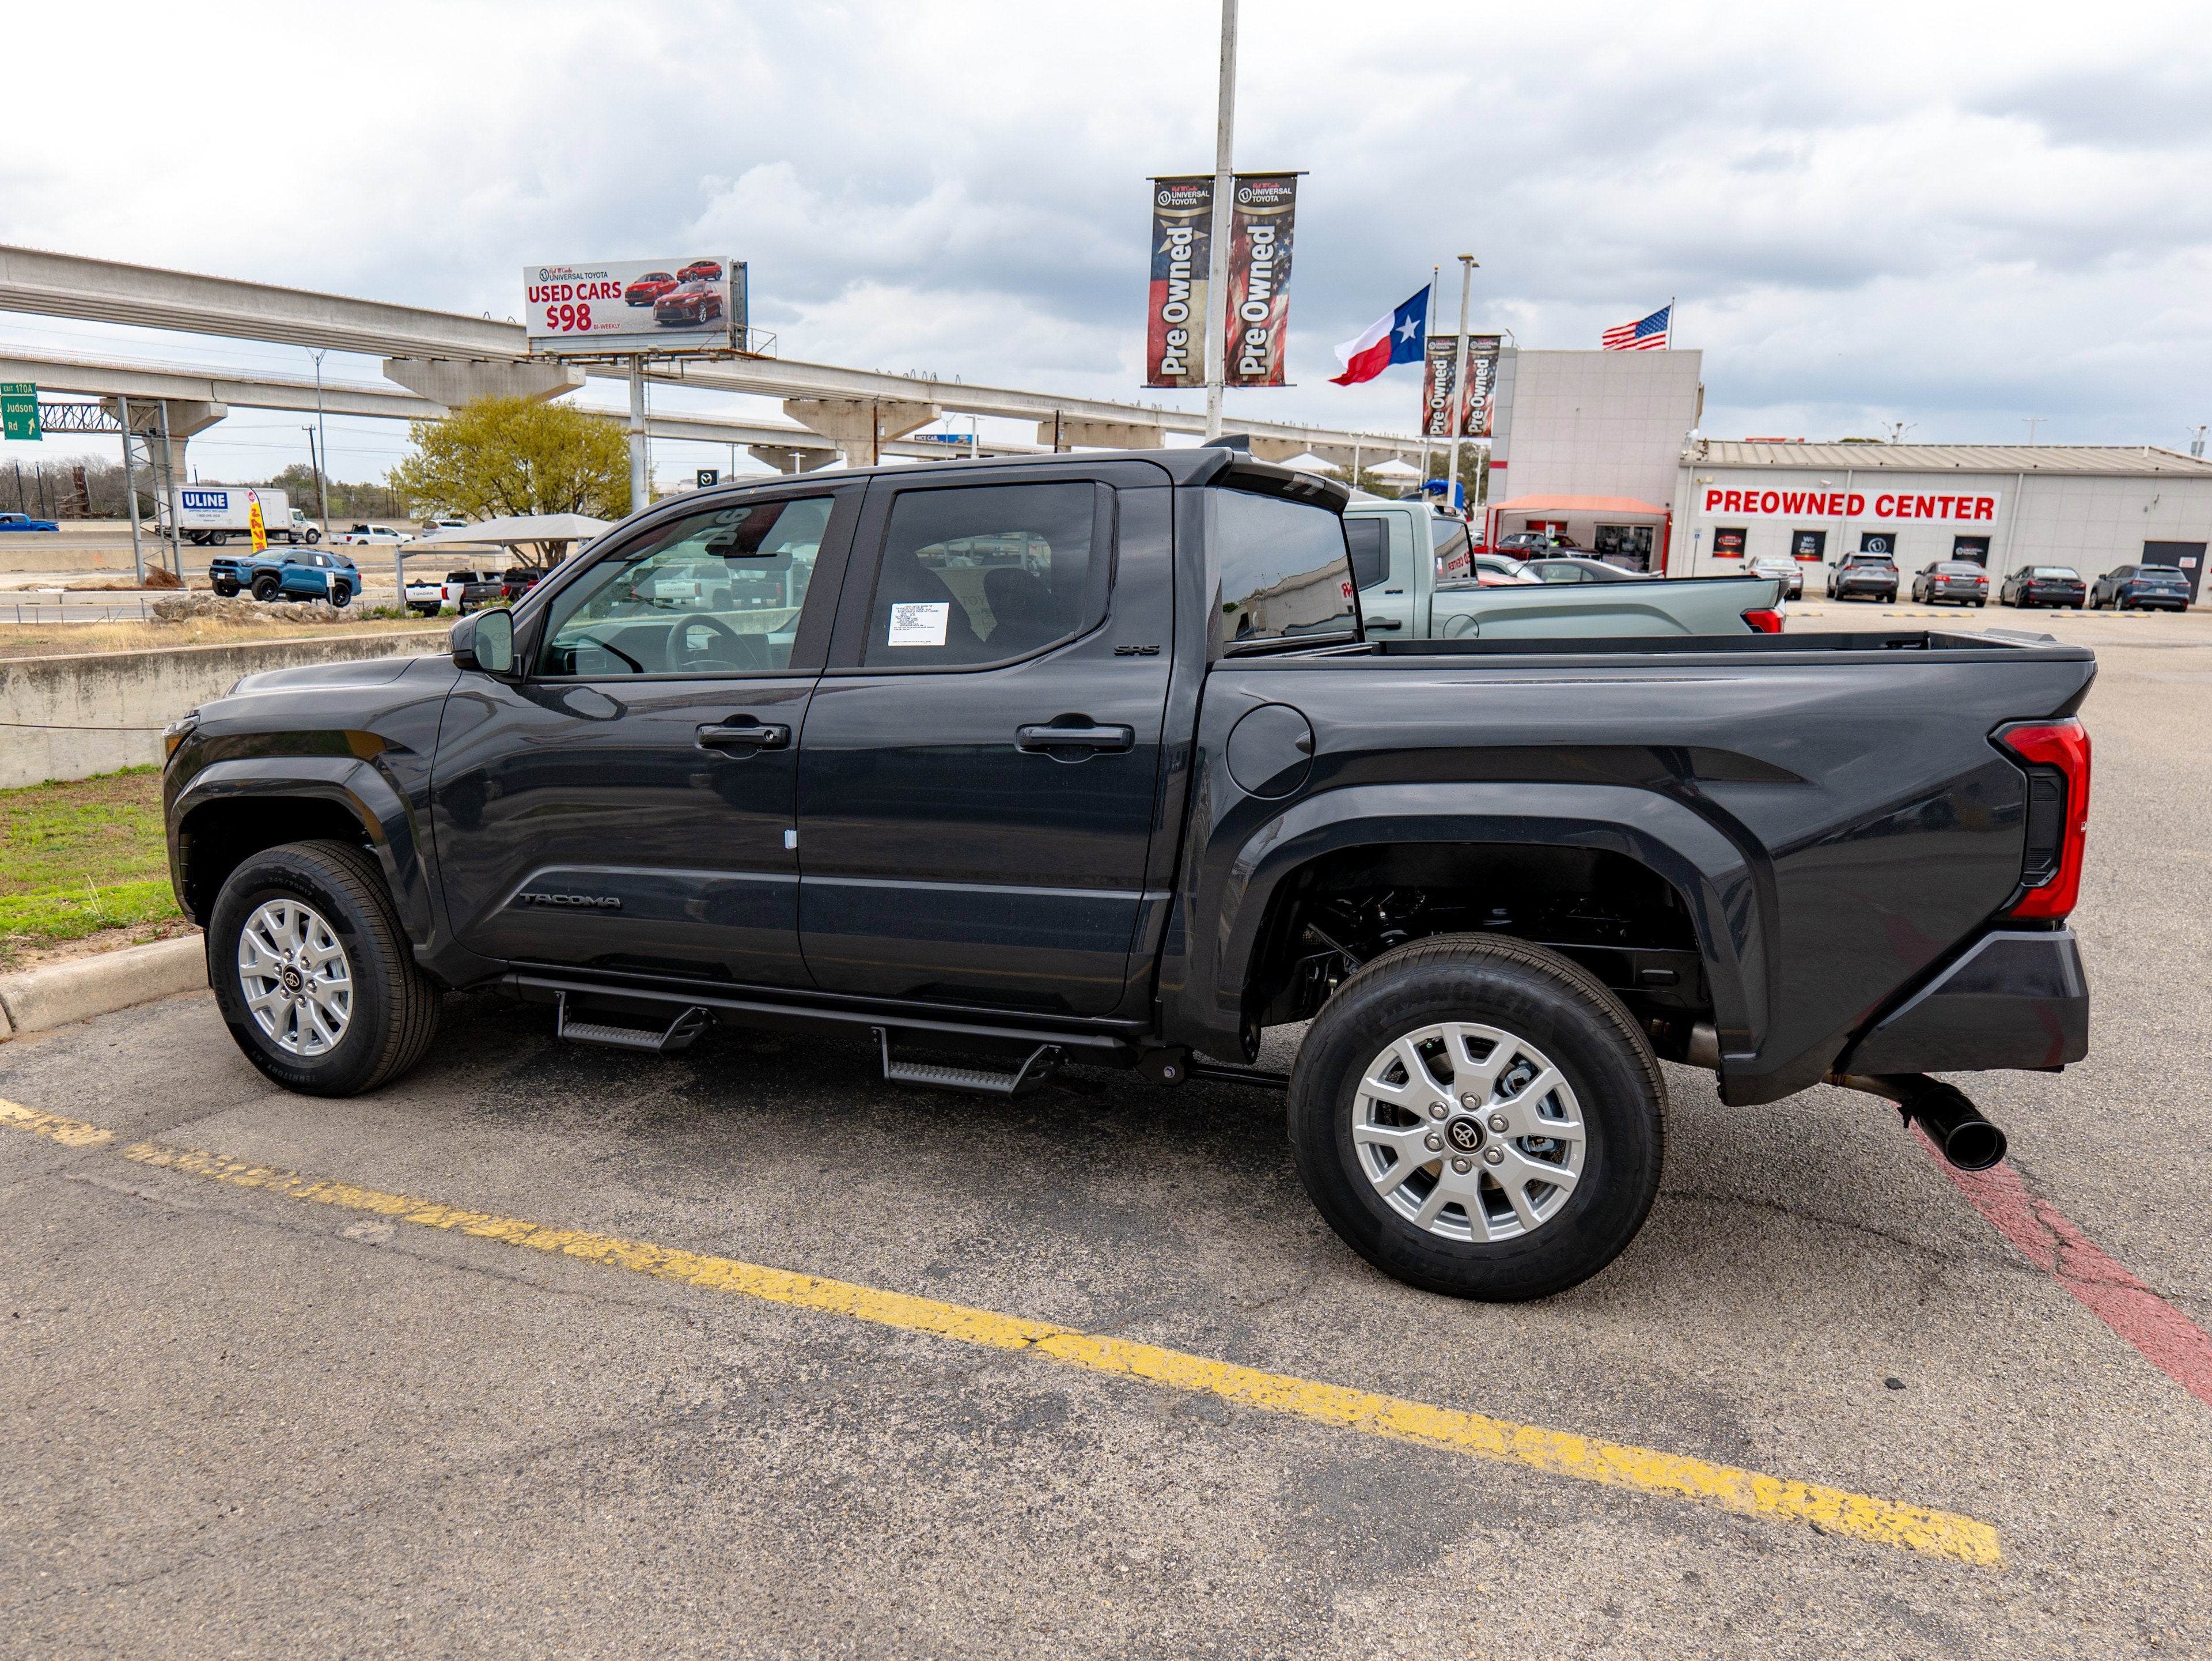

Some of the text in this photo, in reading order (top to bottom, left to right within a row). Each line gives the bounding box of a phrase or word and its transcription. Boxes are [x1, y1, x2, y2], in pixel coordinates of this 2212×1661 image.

[1171, 190, 1210, 199] UNIVERSAL
[1252, 187, 1292, 196] UNIVERSAL
[1171, 198, 1196, 206] TOYOTA
[1252, 195, 1279, 203] TOYOTA
[550, 271, 608, 281] UNIVERSAL TOYOTA
[528, 281, 622, 303] USED CARS
[1160, 226, 1193, 375] Pre Owned
[1239, 225, 1275, 375] Pre Owned
[547, 303, 592, 332] $98
[16, 384, 33, 393] 170A
[1430, 360, 1448, 409] Owned
[1470, 359, 1490, 408] Owned
[6, 403, 34, 413] Judson
[8, 421, 18, 431] Rd
[1429, 411, 1445, 435] Pre
[1468, 410, 1484, 433] Pre
[185, 494, 226, 506] ULINE
[1706, 490, 1994, 520] PREOWNED CENTER
[1113, 645, 1160, 656] SR5
[520, 893, 622, 909] TACOMA
